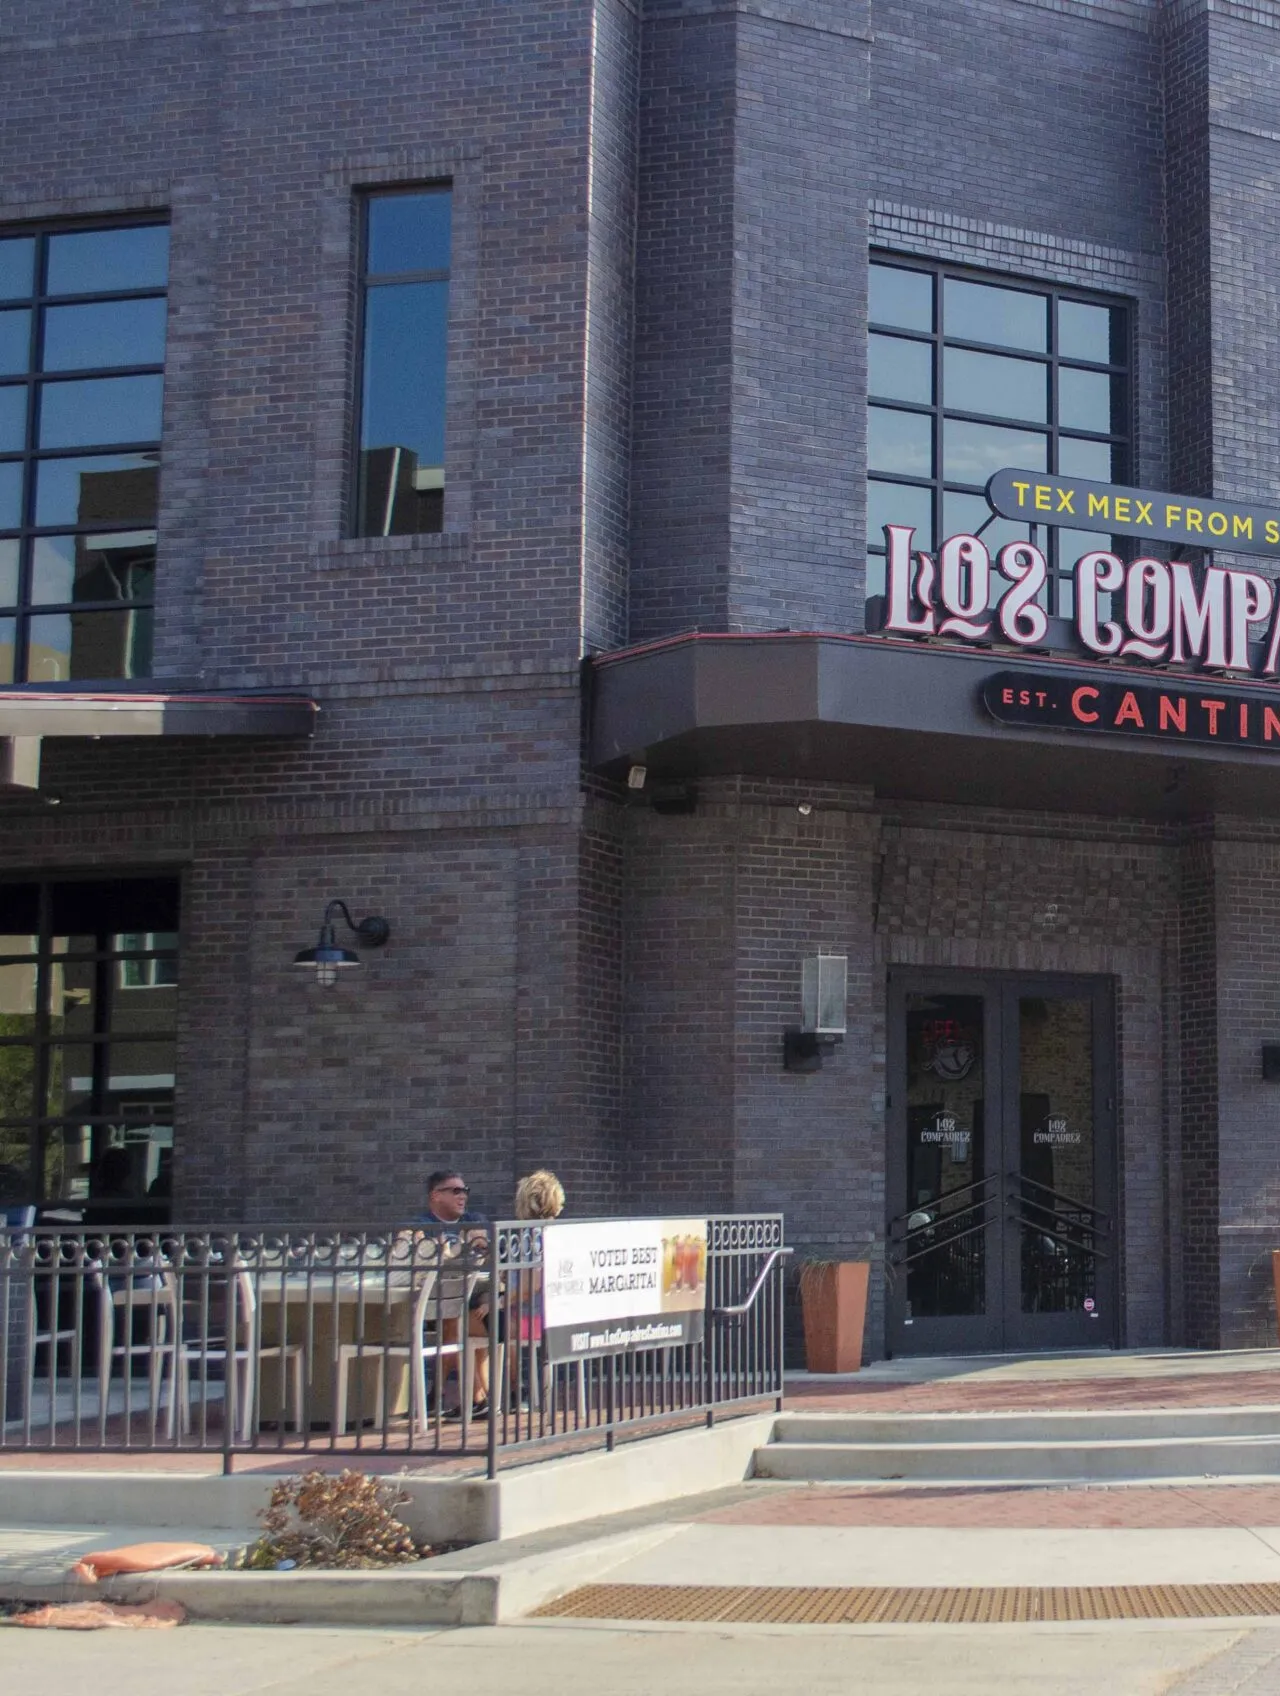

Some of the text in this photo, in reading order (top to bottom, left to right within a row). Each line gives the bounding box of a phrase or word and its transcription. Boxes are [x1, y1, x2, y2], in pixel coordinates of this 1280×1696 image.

[1012, 481, 1075, 514] TEX
[1087, 493, 1153, 525] MEX
[1165, 505, 1253, 540] FROM
[884, 523, 1049, 645] LOS
[1001, 688, 1057, 710] EST.
[936, 1118, 956, 1131] LOS
[1048, 1119, 1066, 1132] LOS
[590, 1247, 658, 1268] VOTED BEST
